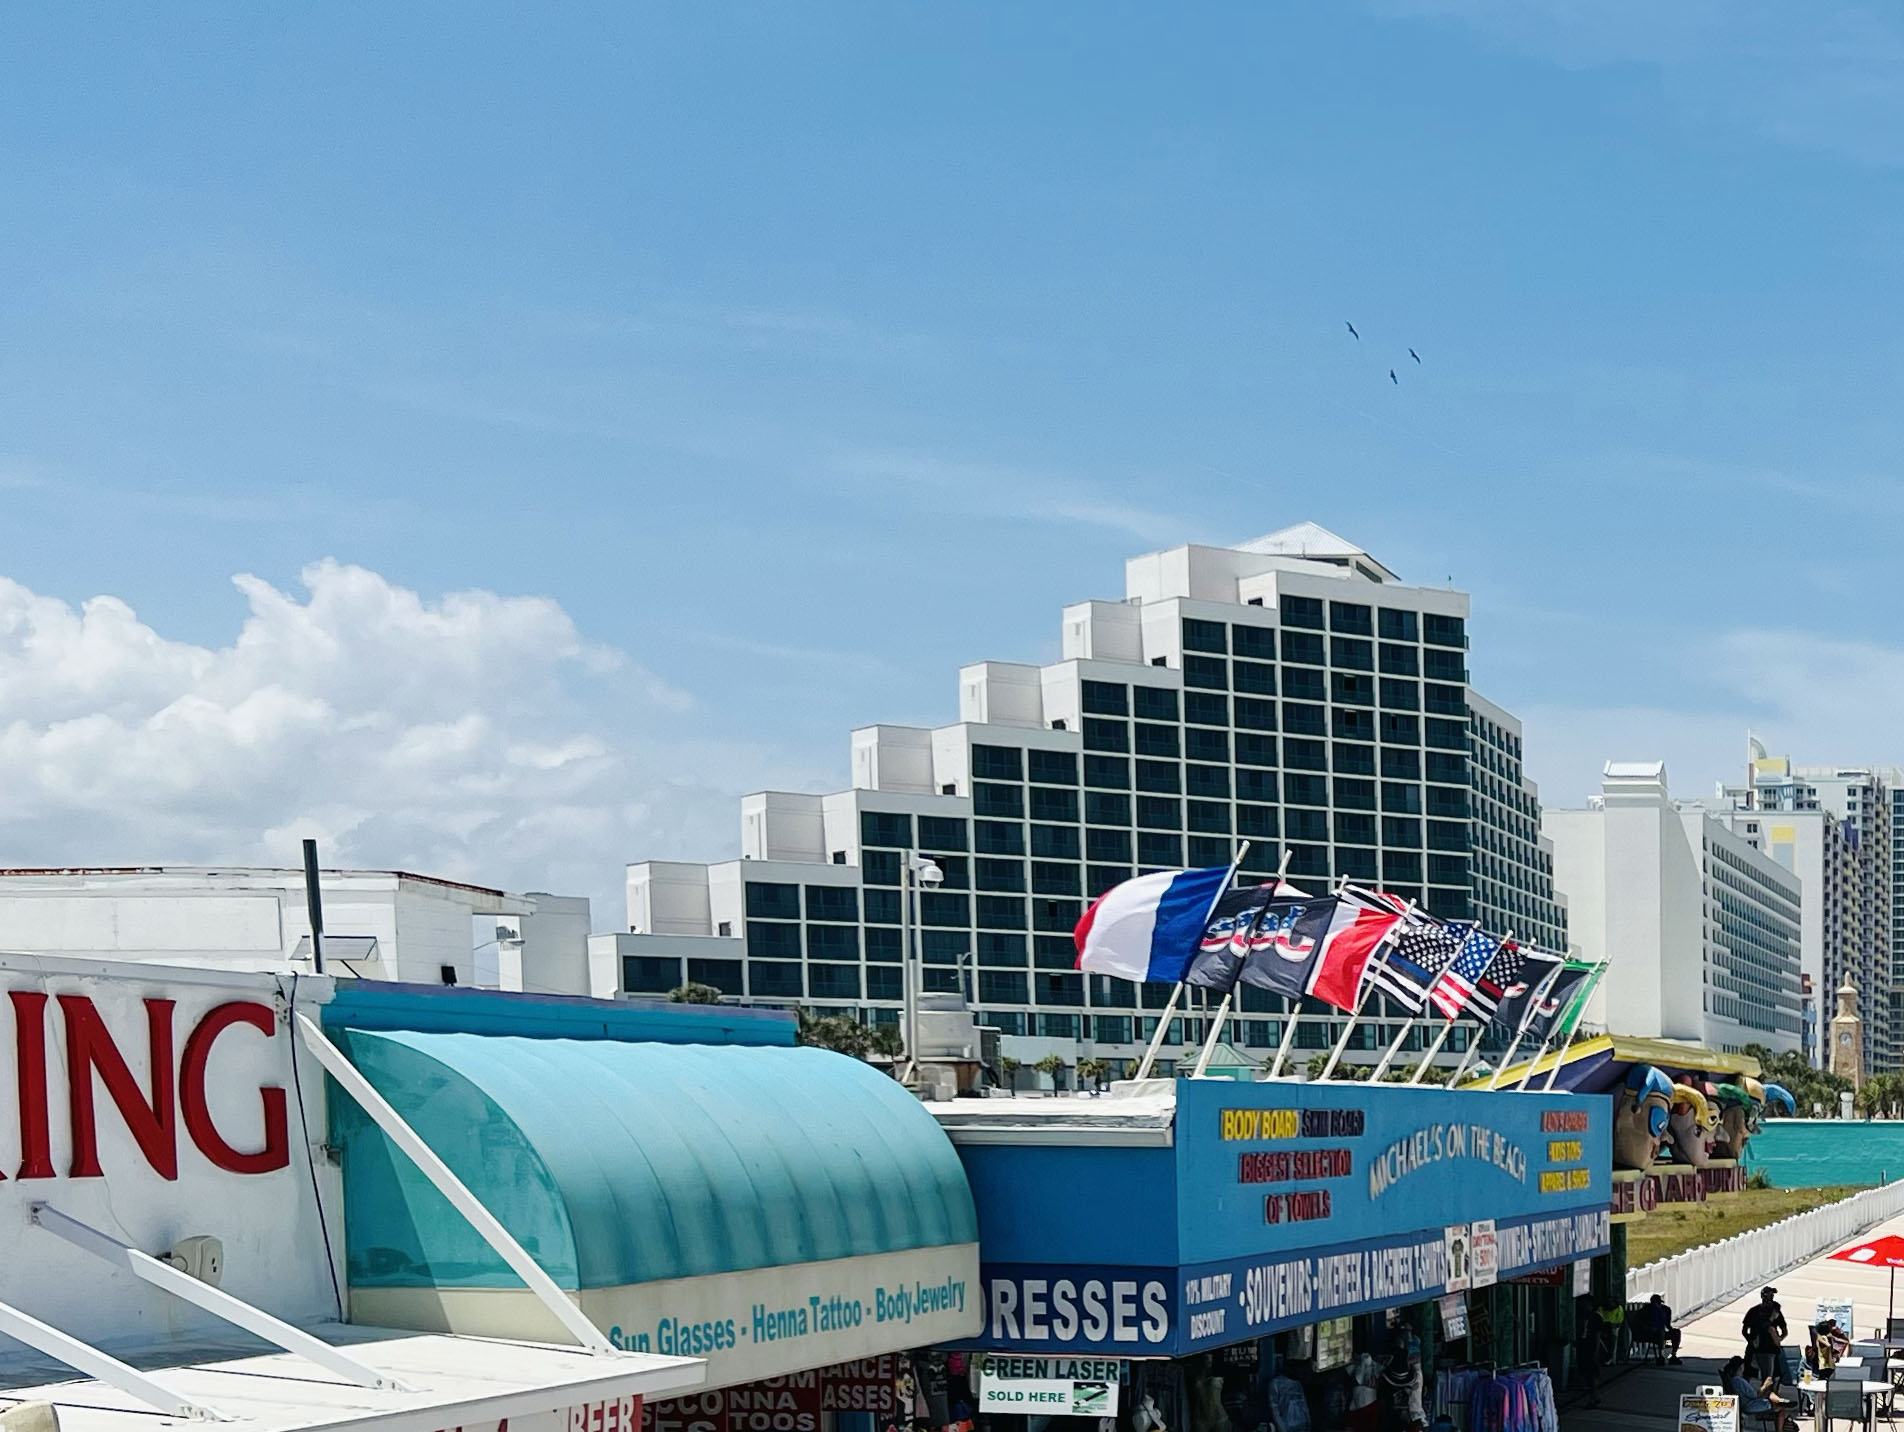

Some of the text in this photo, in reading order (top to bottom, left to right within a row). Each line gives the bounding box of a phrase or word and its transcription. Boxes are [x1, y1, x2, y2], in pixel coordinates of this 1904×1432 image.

[0, 991, 291, 1181] ING
[1223, 1110, 1259, 1141] BODY
[1260, 1110, 1299, 1140] BOARD
[1240, 1152, 1291, 1183] BIGGEST
[1369, 1123, 1527, 1201] MICHAEL'S ON THE BEACH
[1265, 1194, 1284, 1224] OF
[1245, 1258, 1313, 1326] SOUVENIRS
[657, 1317, 736, 1356] Glasses
[752, 1300, 808, 1344] Henna
[809, 1296, 862, 1334] Tattoo
[876, 1284, 912, 1325] Body
[913, 1276, 965, 1314] Jewelry
[980, 1279, 1169, 1343] RESSES
[1190, 1308, 1226, 1340] DISCOUNT
[981, 1357, 1120, 1381] GREEN LASER
[987, 1389, 1066, 1404] SOLD HERE
